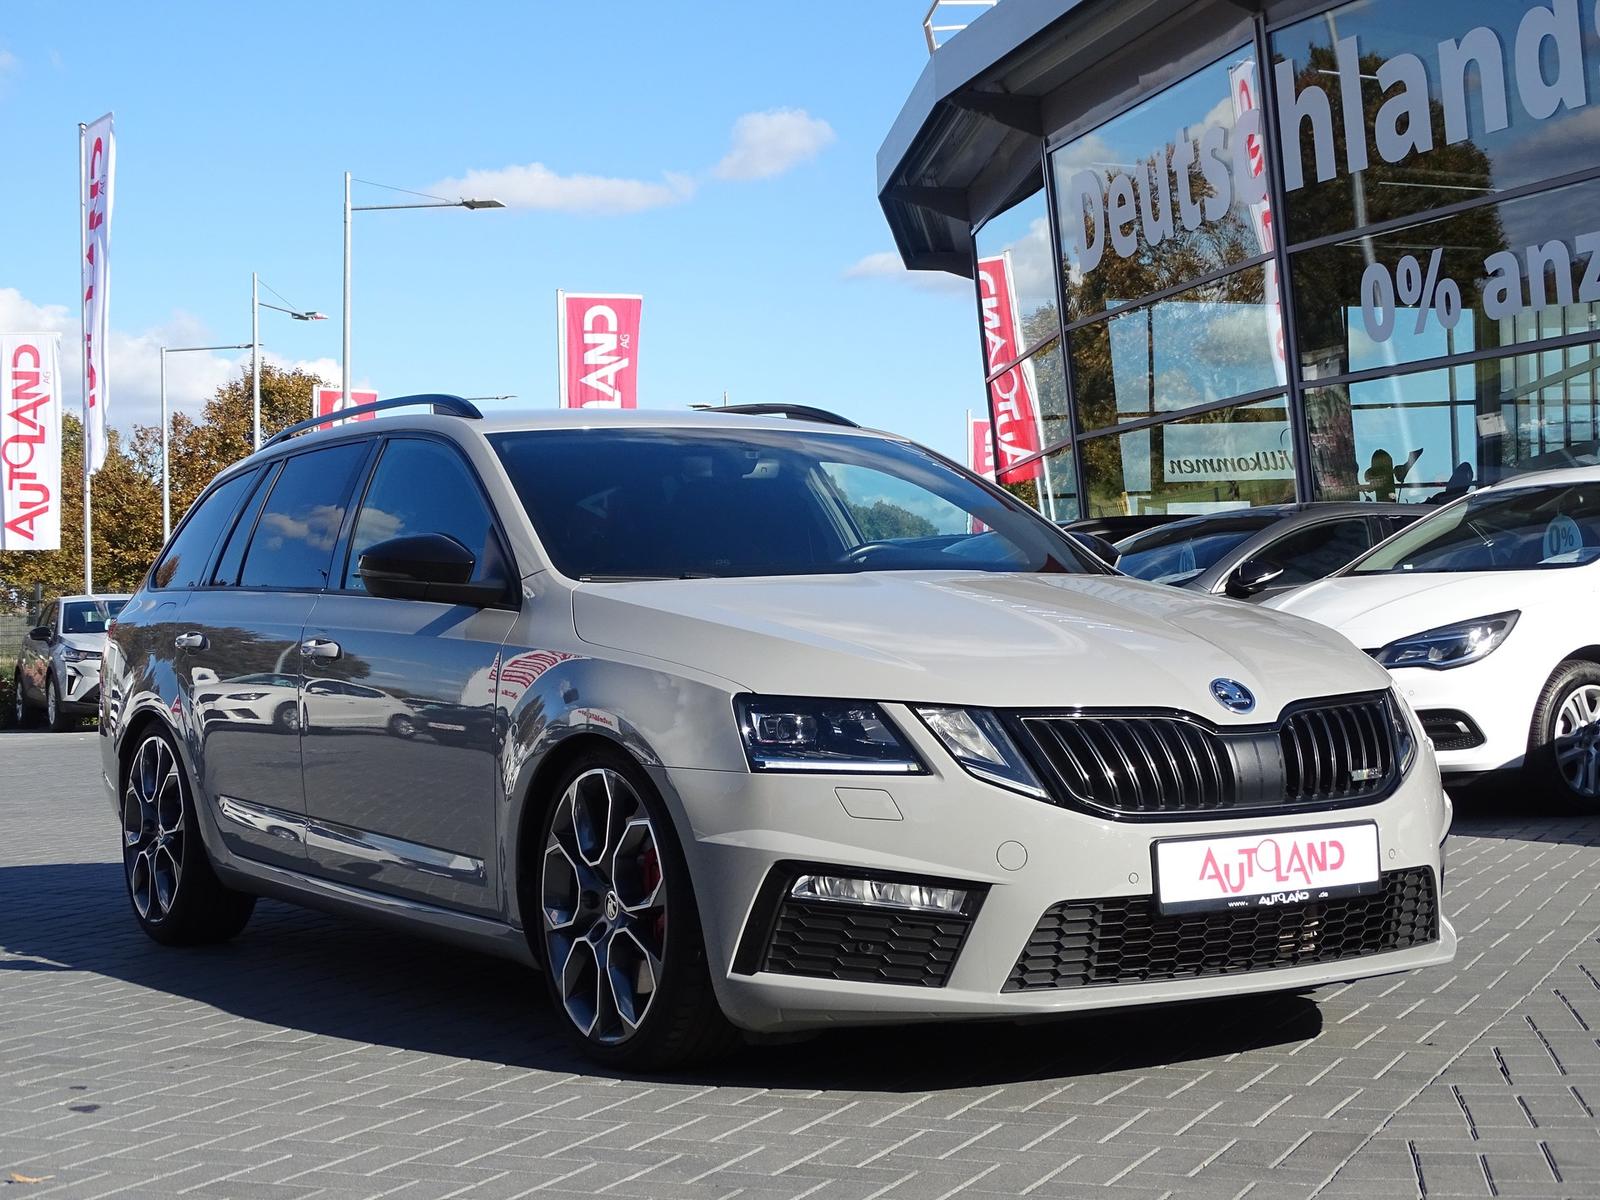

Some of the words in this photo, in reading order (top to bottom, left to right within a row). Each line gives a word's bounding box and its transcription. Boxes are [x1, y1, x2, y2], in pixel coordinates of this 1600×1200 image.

[1071, 0, 1600, 276] Deutschland
[1361, 247, 1462, 343] 0%
[1, 344, 51, 541] AUTOLAND
[1548, 524, 1575, 556] 0%
[1199, 838, 1345, 893] AUTOLAND
[1228, 900, 1249, 908] www.
[1258, 890, 1310, 906] AUTOLAND
